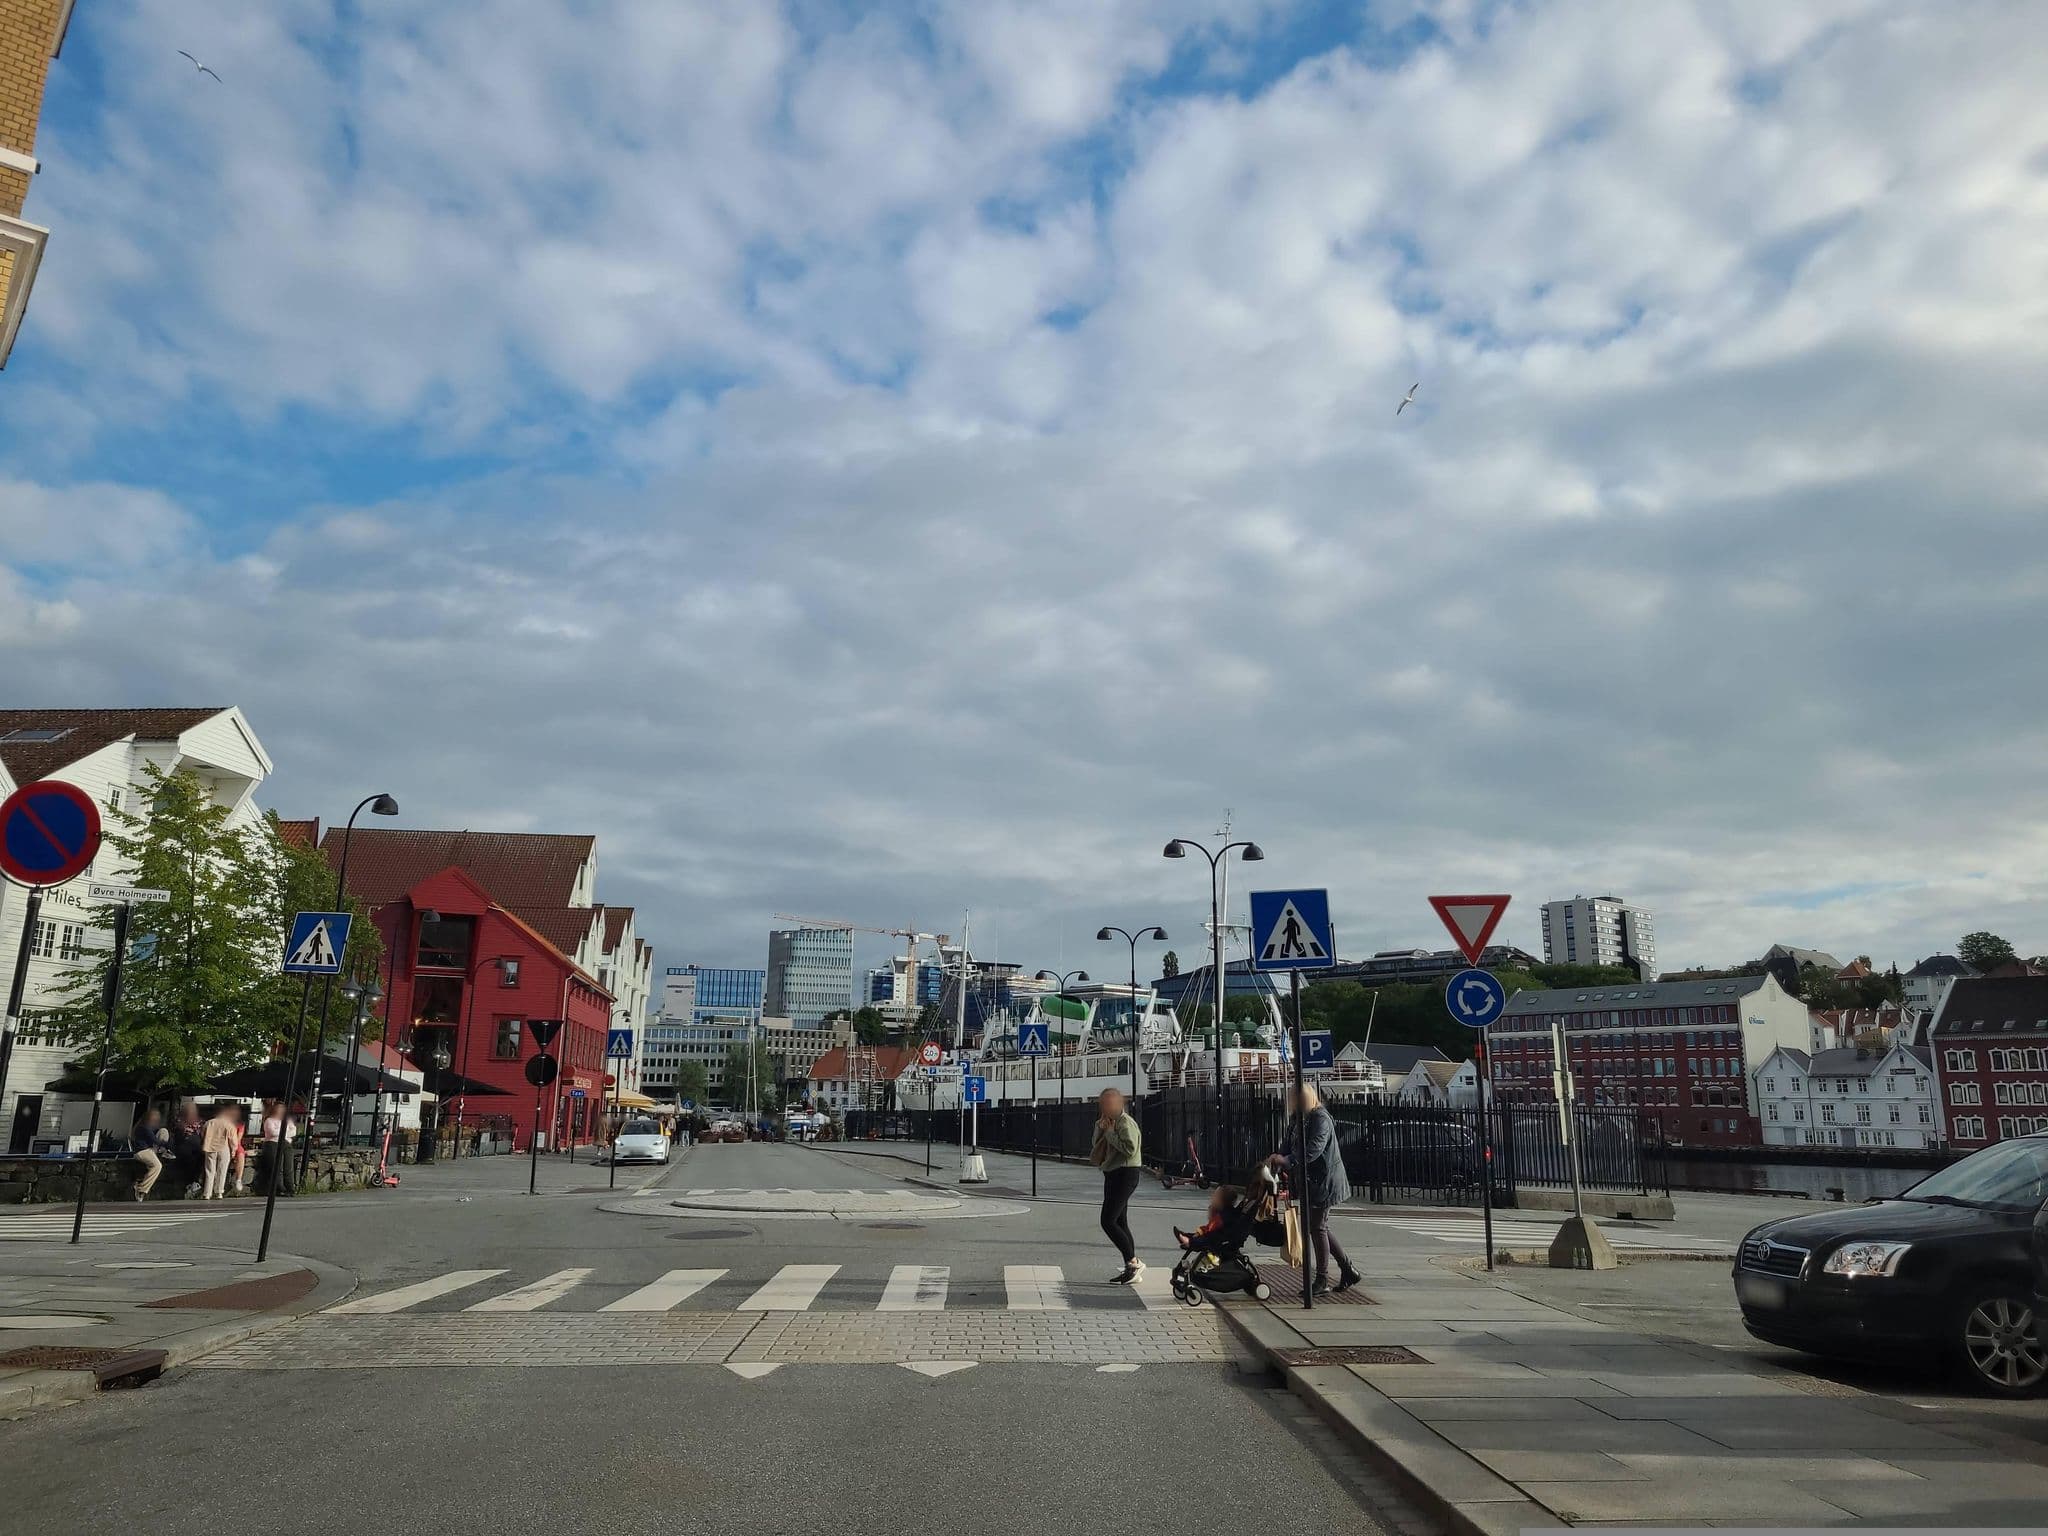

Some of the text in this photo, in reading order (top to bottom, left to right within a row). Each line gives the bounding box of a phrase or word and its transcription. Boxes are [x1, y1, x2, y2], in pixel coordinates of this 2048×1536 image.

[46, 888, 82, 907] Miles
[93, 887, 167, 900] Øvre Holmegate
[1309, 1039, 1322, 1056] P
